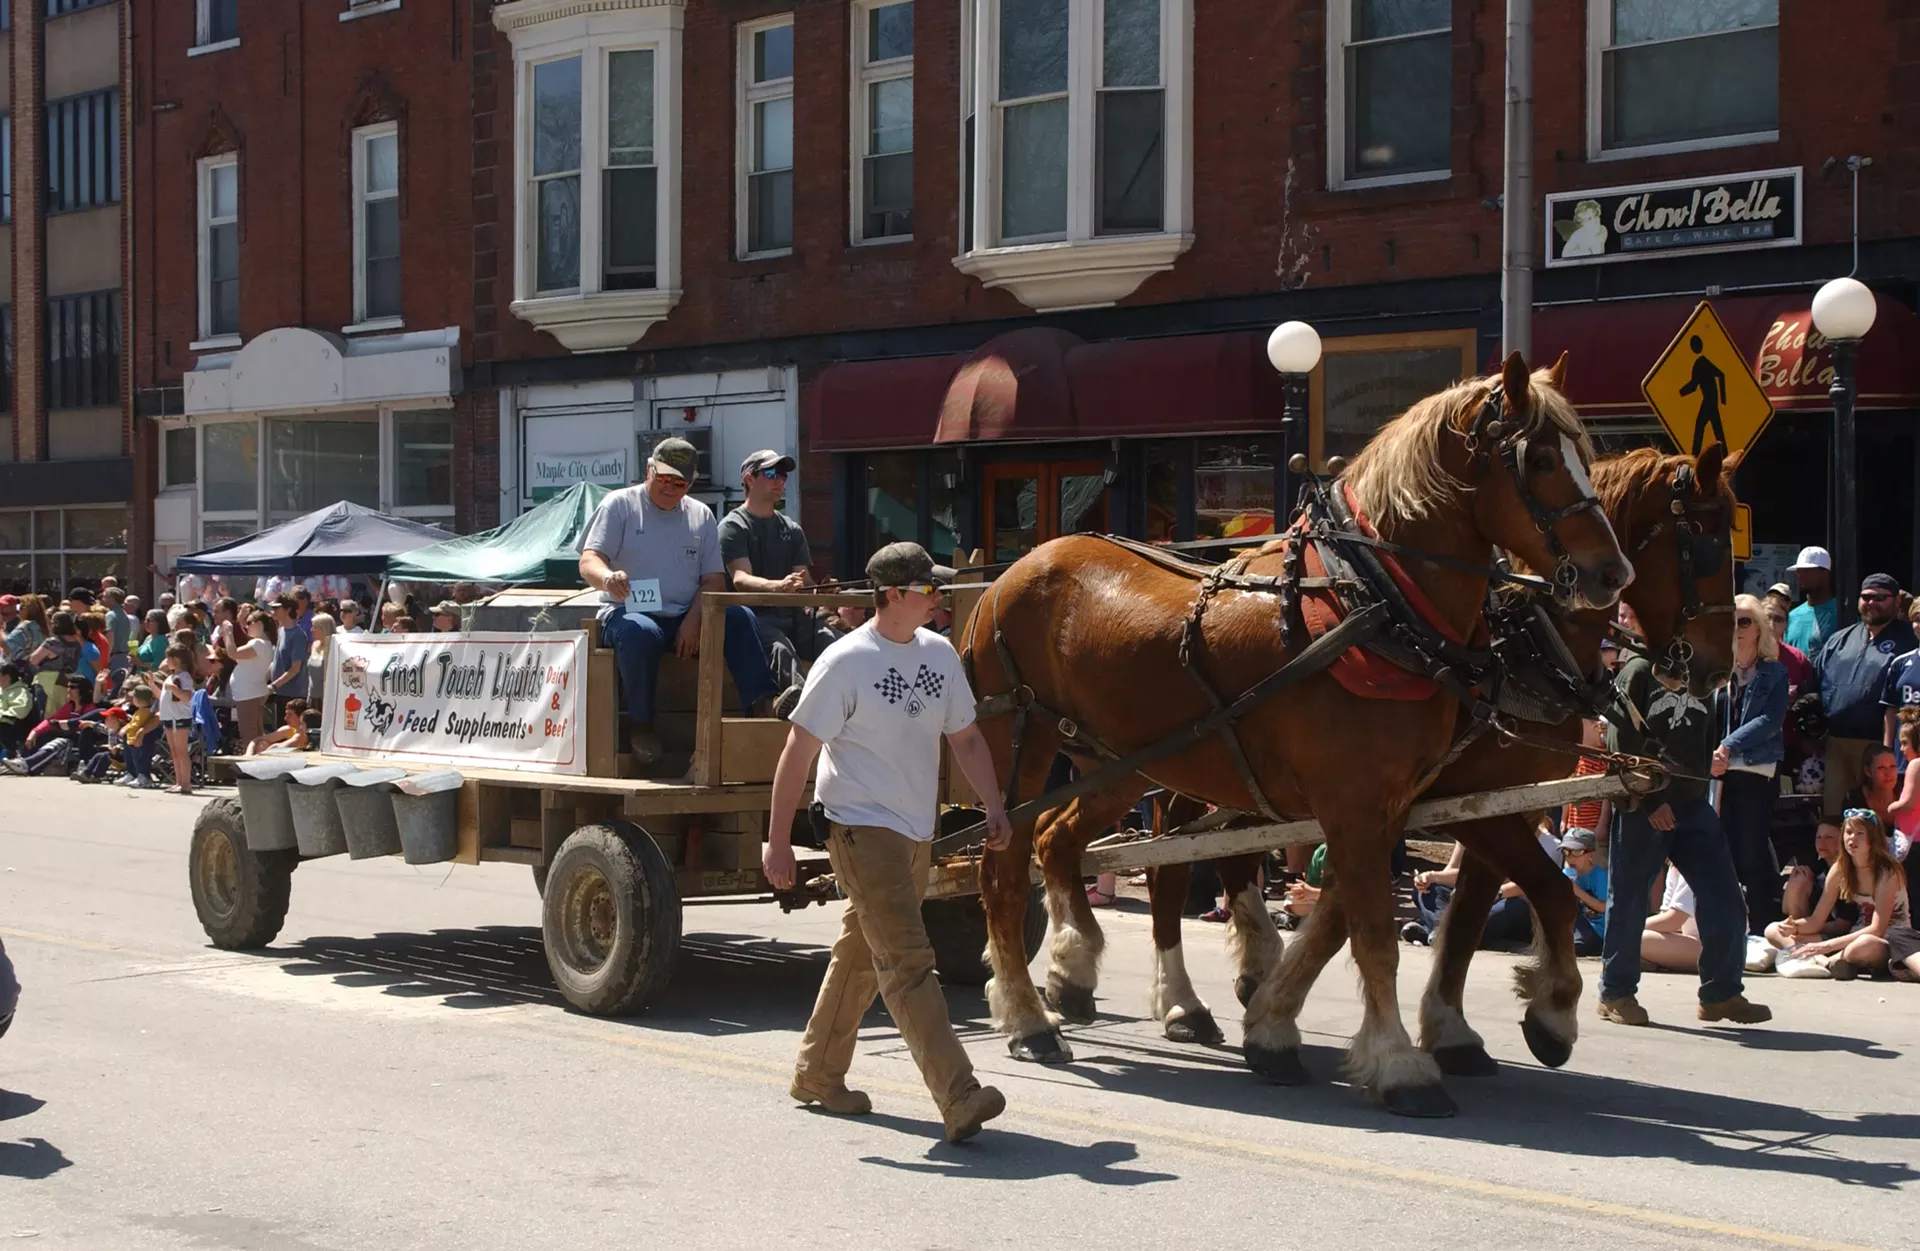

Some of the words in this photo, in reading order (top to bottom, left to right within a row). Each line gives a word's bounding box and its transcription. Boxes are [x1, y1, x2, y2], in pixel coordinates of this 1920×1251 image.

[1613, 189, 1700, 234] Chow!
[1703, 180, 1781, 224] Bella
[1672, 232, 1681, 242] &
[1693, 229, 1732, 240] WINE
[1742, 225, 1772, 236] BAR
[1759, 354, 1836, 388] Bella
[535, 461, 566, 483] Maple
[568, 460, 588, 481] City
[591, 457, 624, 480] Candy
[631, 589, 656, 603] 122
[381, 650, 429, 698] Final
[436, 650, 486, 699] Touch
[491, 650, 545, 715] Liquids
[545, 665, 569, 690] Dairy
[551, 692, 561, 710] &
[402, 709, 440, 734] Feed
[444, 711, 527, 744] Supplements
[544, 718, 568, 737] Beef
